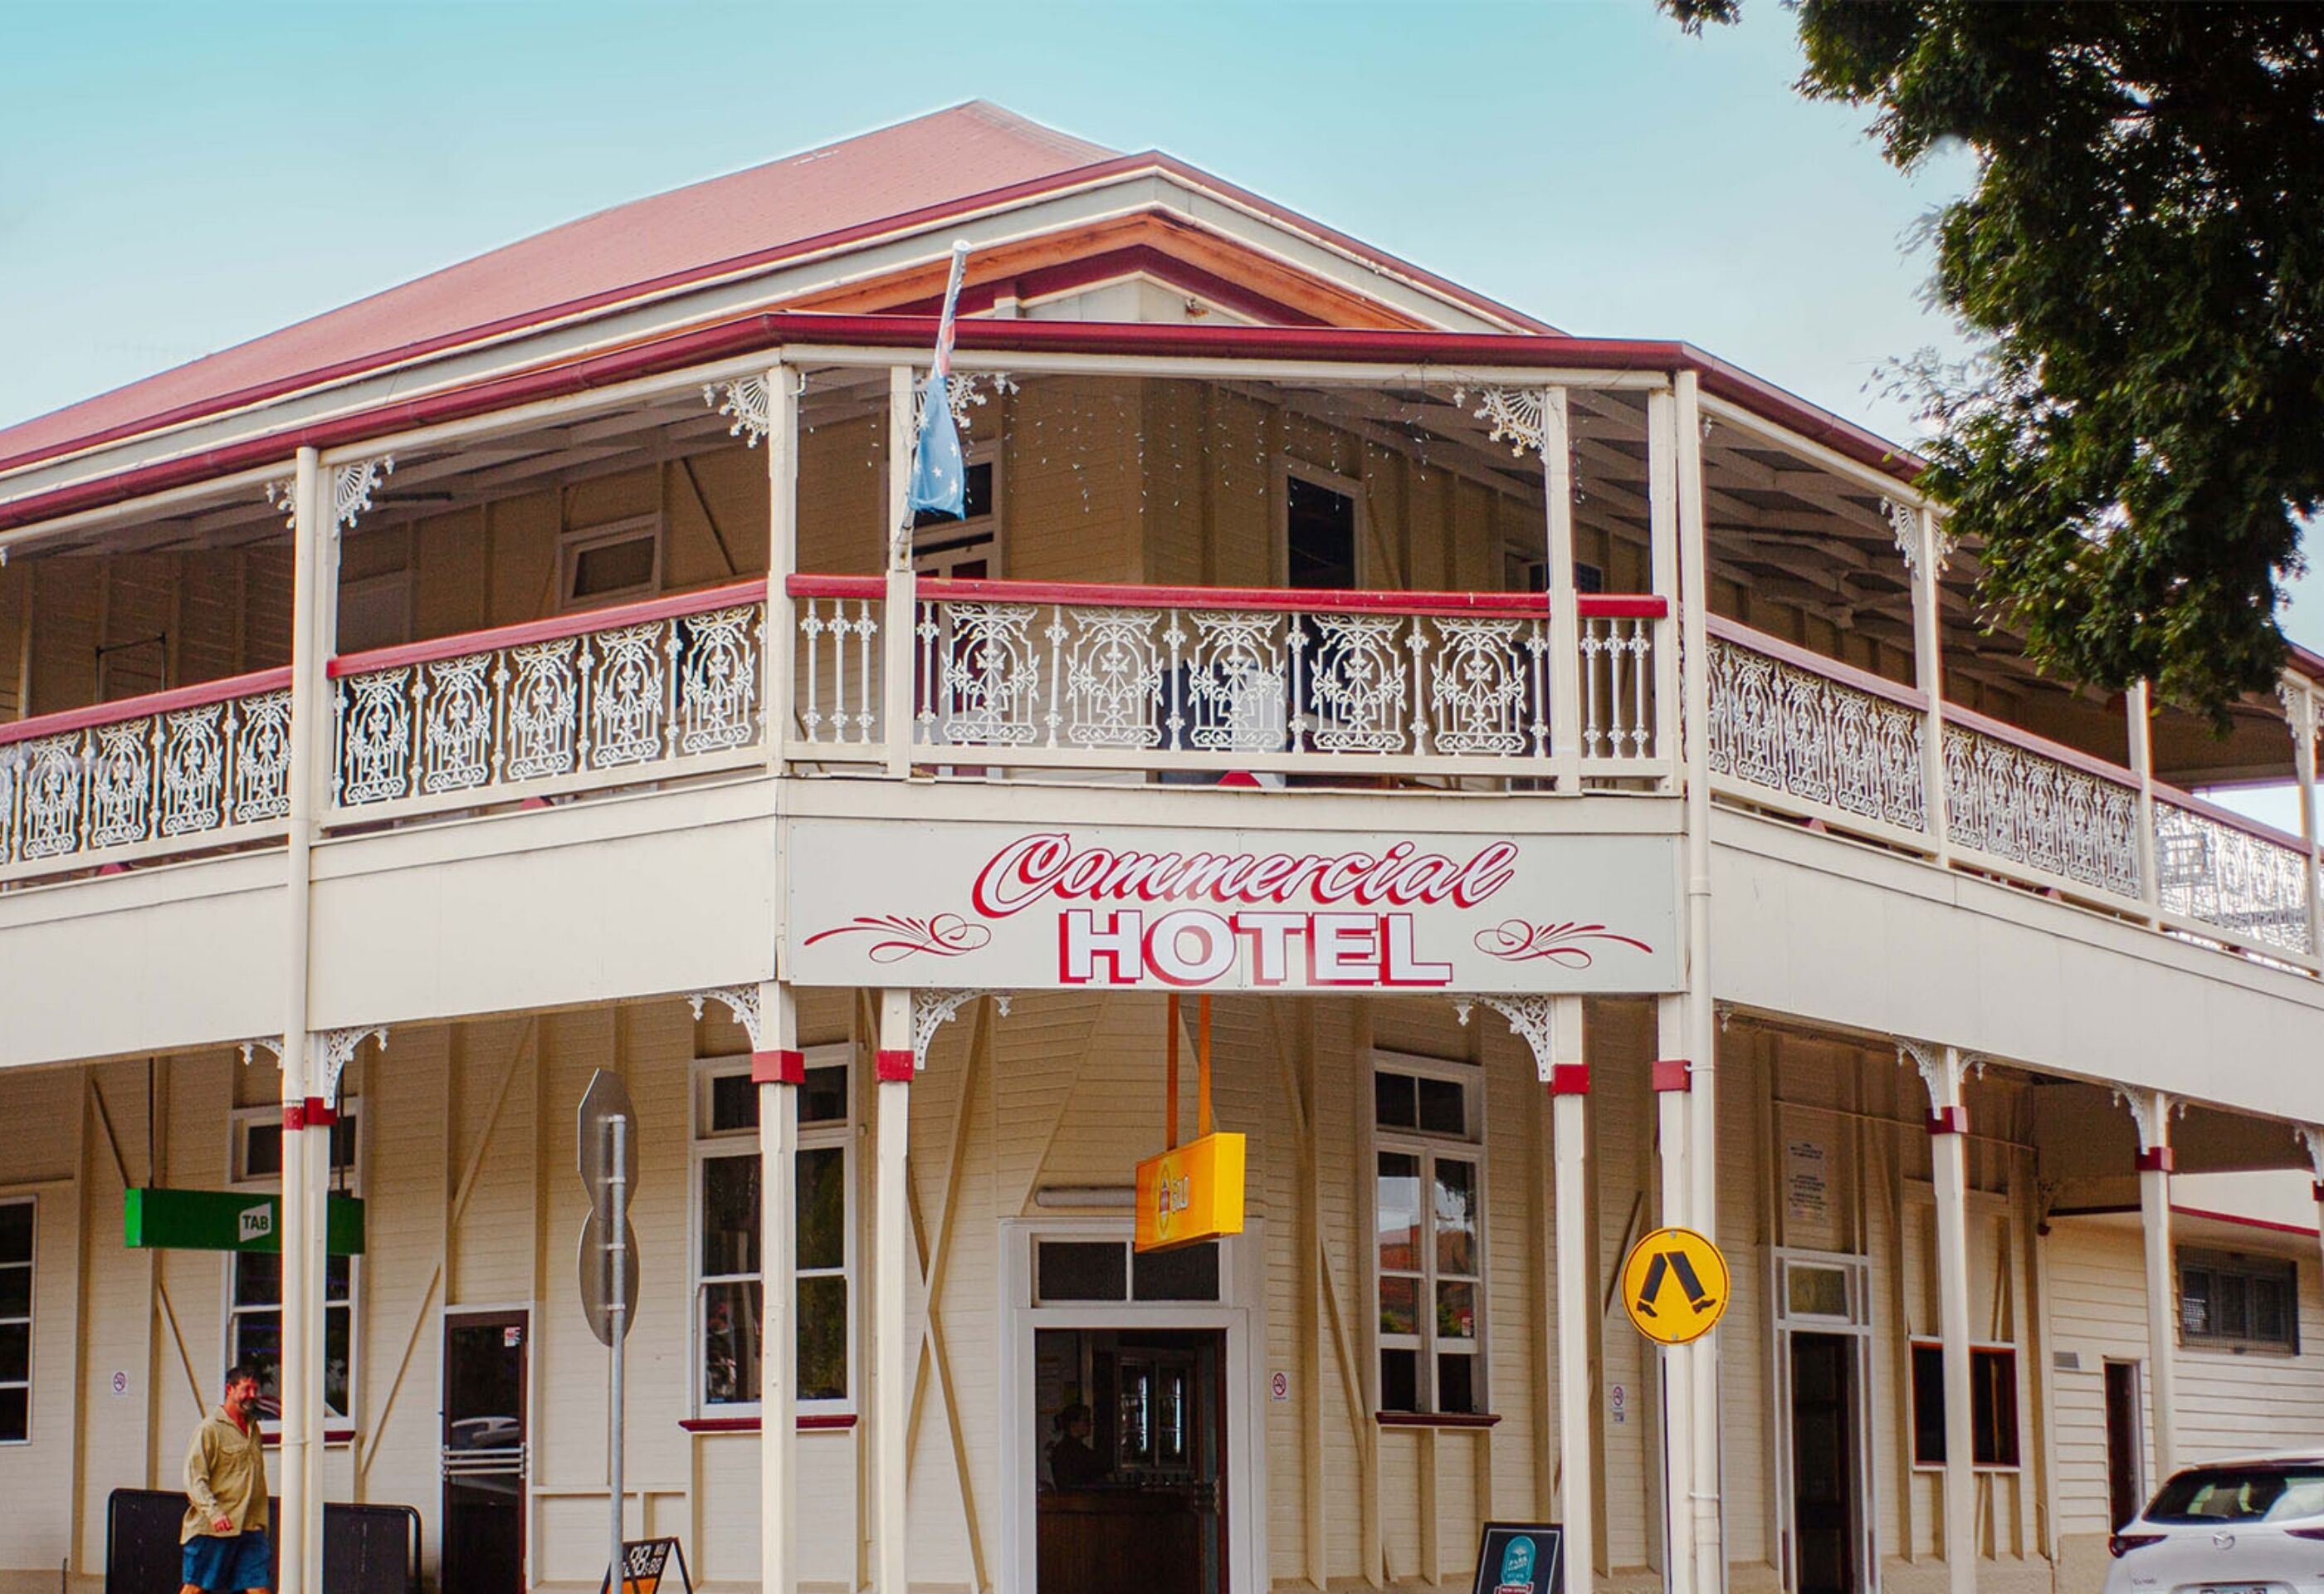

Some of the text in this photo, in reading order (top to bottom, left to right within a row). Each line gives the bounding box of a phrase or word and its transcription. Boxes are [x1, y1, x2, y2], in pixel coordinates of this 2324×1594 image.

[972, 833, 1518, 918] Commercial
[1058, 908, 1452, 986] HOTEL
[242, 1215, 269, 1230] TAB
